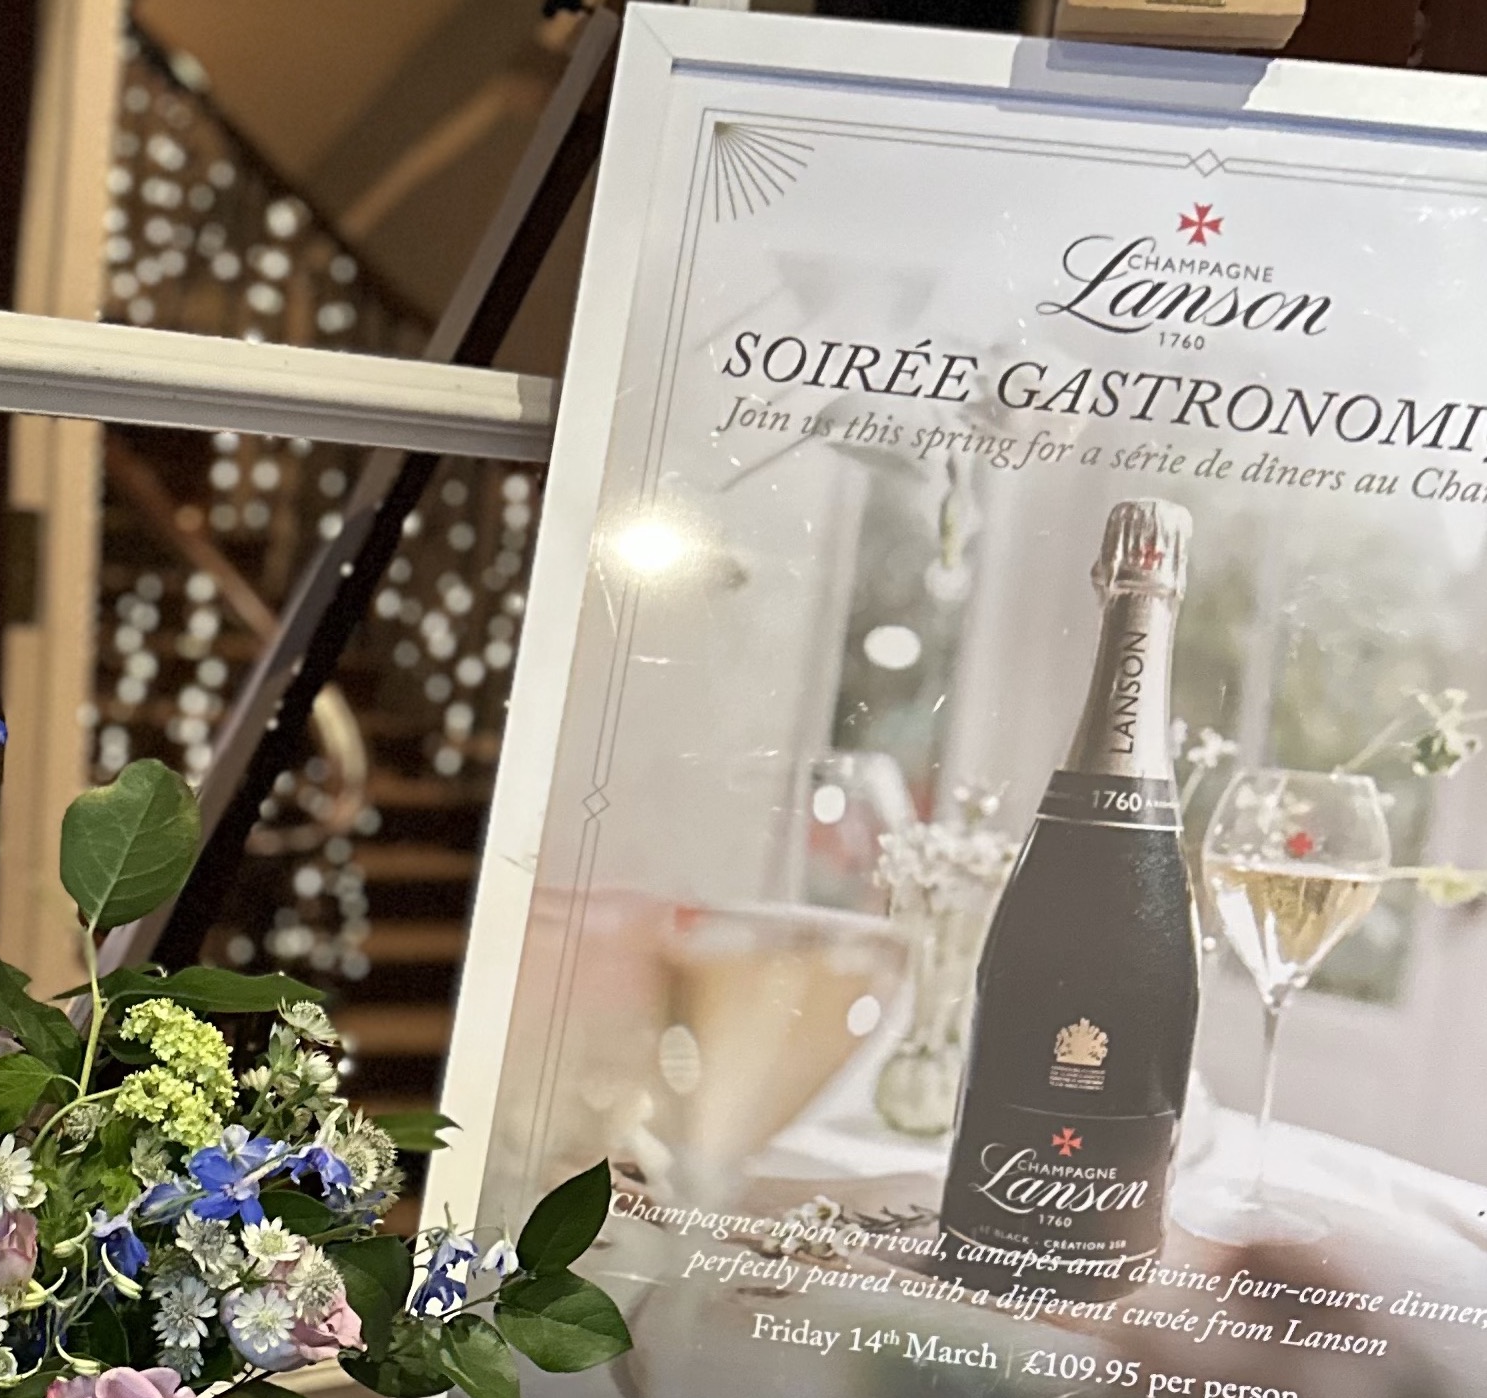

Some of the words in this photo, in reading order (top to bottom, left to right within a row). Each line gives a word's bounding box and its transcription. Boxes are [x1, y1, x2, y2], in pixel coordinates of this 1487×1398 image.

[1036, 235, 1331, 335] Lanson
[1127, 253, 1275, 284] CHAMPAGNE
[1159, 331, 1205, 351] 1760
[722, 331, 979, 403] SOIRÉE
[997, 361, 1487, 463] GASTRONOMI
[716, 396, 791, 432] Join
[801, 414, 833, 438] us
[843, 411, 903, 445] this
[911, 424, 1016, 469] spring
[1013, 430, 1074, 470] for
[1080, 445, 1102, 466] a
[1110, 440, 1183, 475] série
[1194, 448, 1233, 481] de
[1241, 452, 1346, 491] dîners
[1353, 471, 1399, 495] au
[1109, 631, 1147, 754] LANSON
[1091, 789, 1143, 813] 1760
[968, 1143, 1149, 1214] Lanson
[1017, 1159, 1118, 1180] CHAMPAGNE
[608, 1192, 765, 1240] Champagne
[772, 1219, 836, 1248] upon
[843, 1226, 948, 1262] arrival,
[957, 1244, 1062, 1278] canapés
[1067, 1255, 1127, 1279] and
[1129, 1258, 1221, 1292] divine
[1216, 1269, 1384, 1313] four-course
[1038, 1213, 1073, 1228] 1760
[1043, 1238, 1106, 1251] CRÉATION
[682, 1249, 800, 1287] perfectly
[799, 1263, 897, 1294] paired
[900, 1275, 965, 1303] with
[971, 1288, 990, 1306] a
[995, 1284, 1118, 1321] different
[1122, 1305, 1200, 1333] cuvée
[1194, 1309, 1275, 1343] from
[1280, 1319, 1388, 1357] Lanson
[751, 1312, 841, 1356] Friday
[902, 1331, 998, 1369] March
[1021, 1350, 1141, 1387] £109.95
[1147, 1372, 1196, 1398] per
